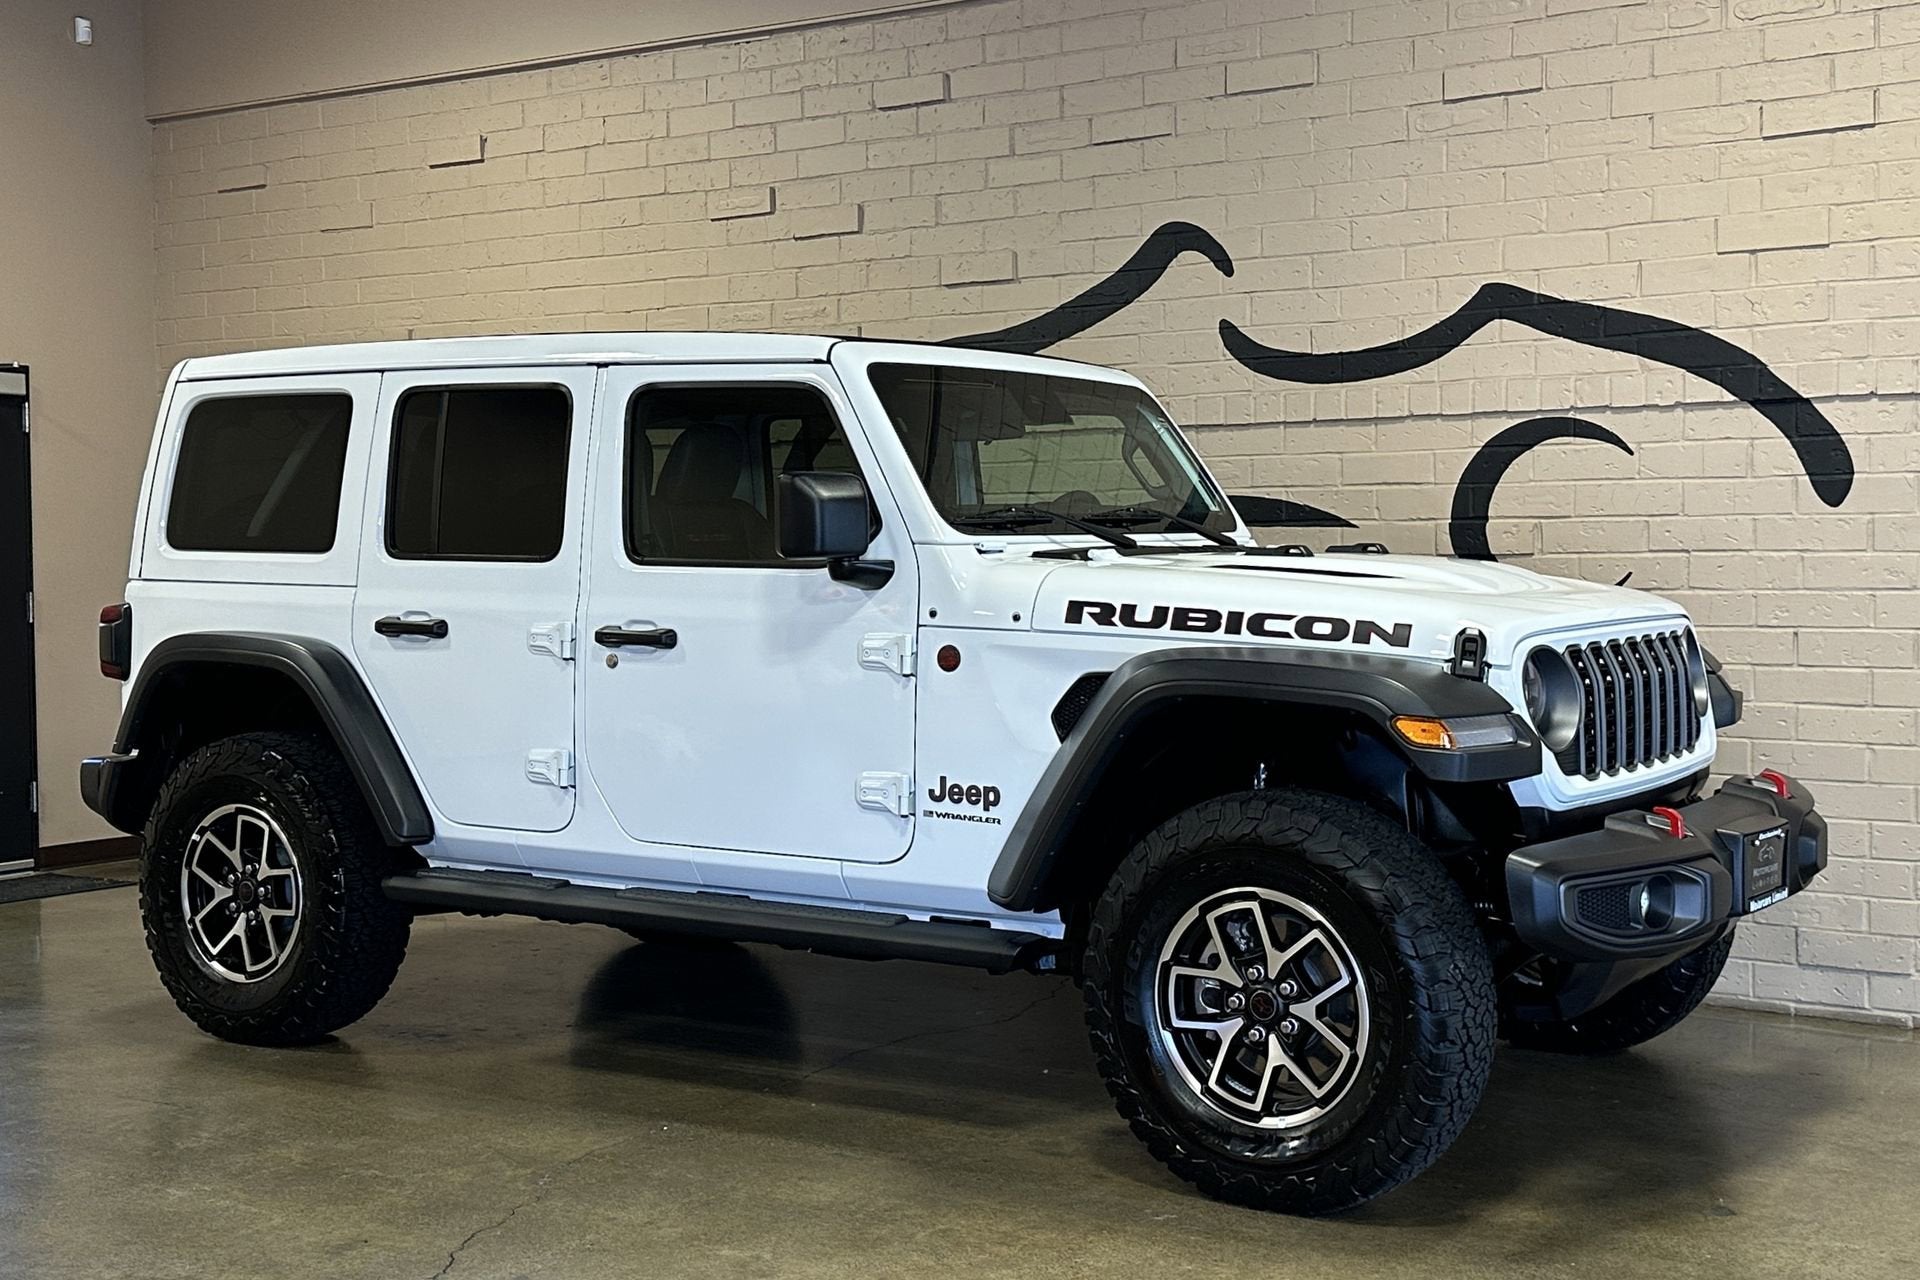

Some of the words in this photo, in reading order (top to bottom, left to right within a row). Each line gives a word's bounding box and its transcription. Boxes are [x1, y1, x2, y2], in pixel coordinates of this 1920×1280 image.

[1064, 600, 1413, 648] RUBICON
[928, 775, 1001, 812] Jeep
[934, 810, 1002, 825] WRANGLER
